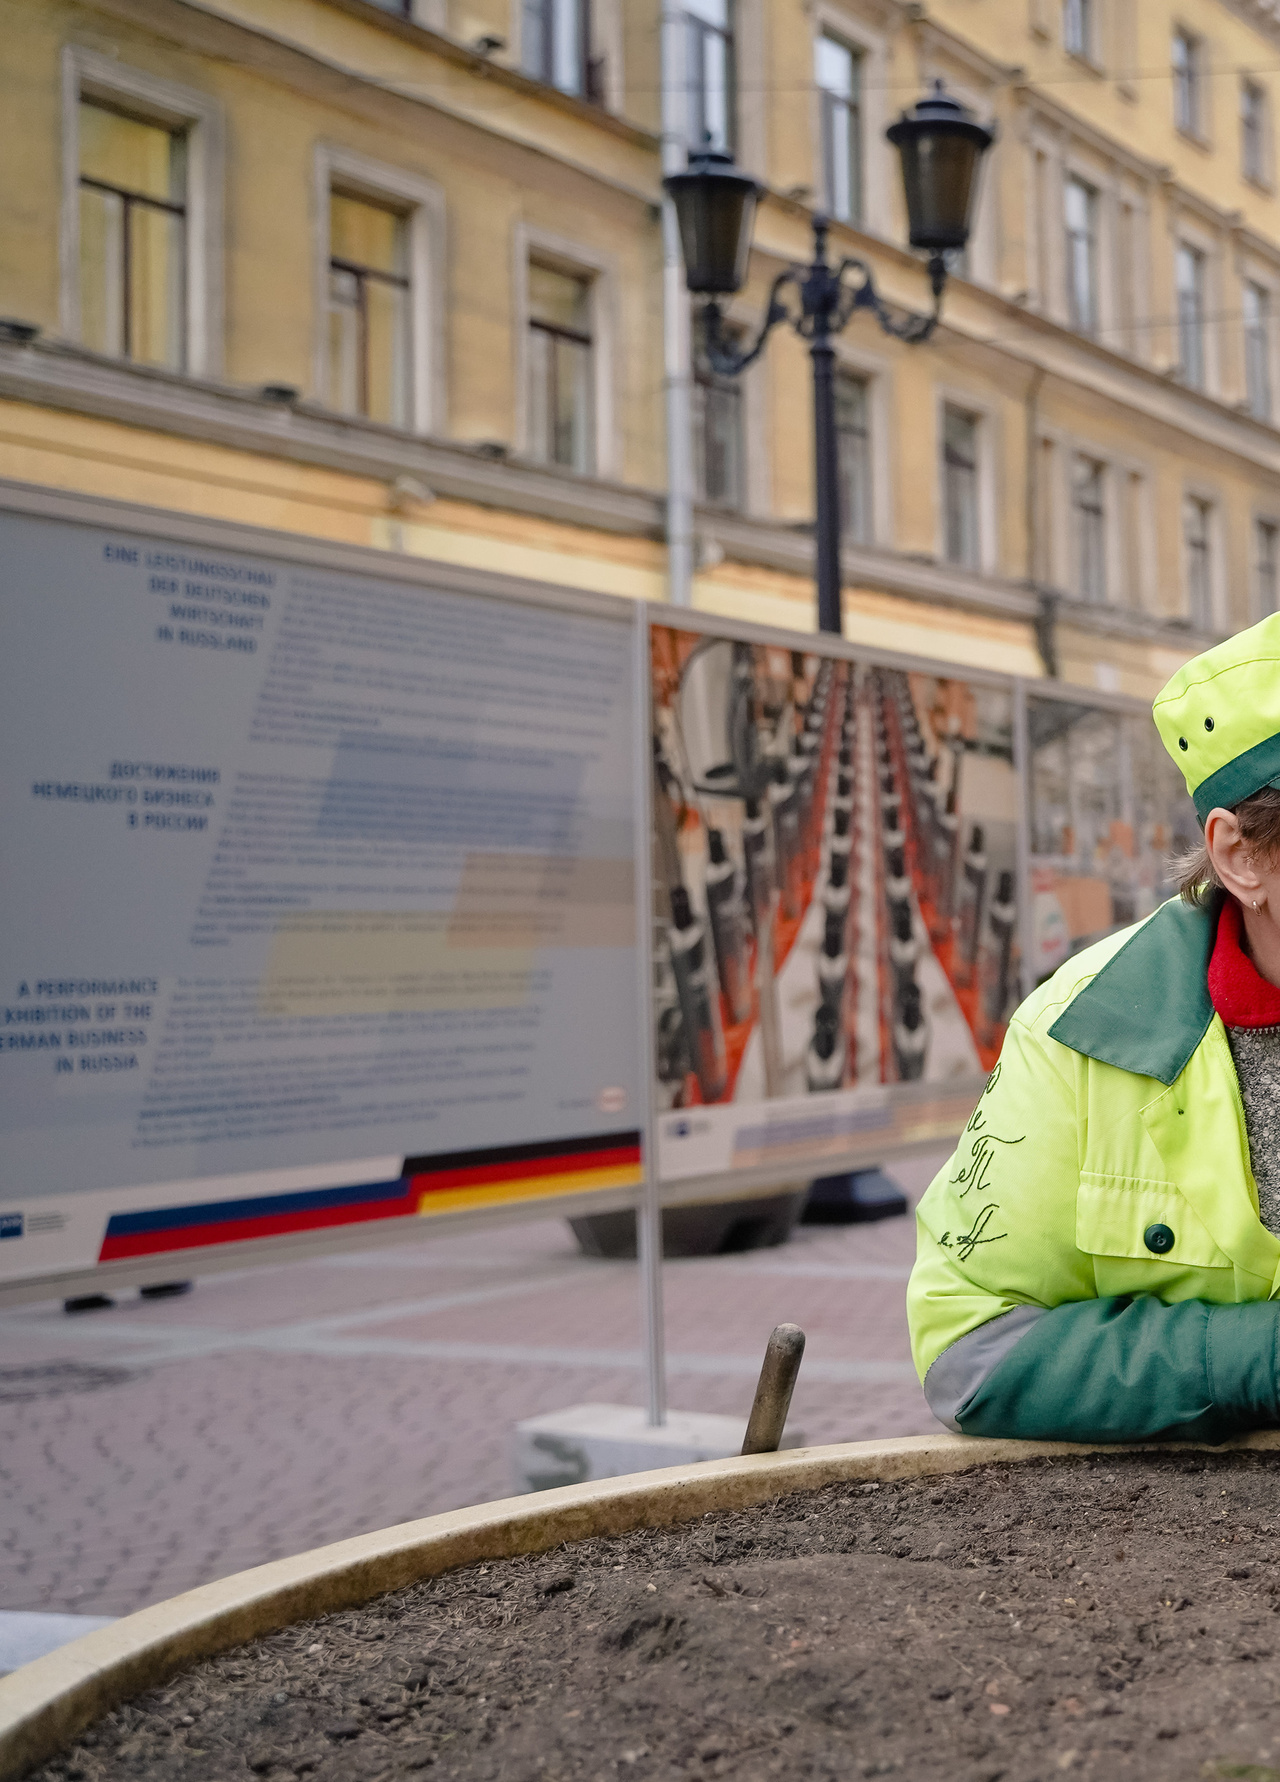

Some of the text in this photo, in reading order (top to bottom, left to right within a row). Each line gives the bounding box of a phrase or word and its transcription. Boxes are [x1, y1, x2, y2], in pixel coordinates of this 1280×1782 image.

[33, 783, 213, 807] НЕМЕЦКОГО БИЗНЕСА
[144, 813, 207, 829] РОССИИ
[19, 979, 157, 997] A PERFORMANCE
[4, 1003, 151, 1025] XHIBITION OF THE
[68, 1030, 146, 1047] BUSINESS
[56, 1054, 138, 1071] IN RUSSIA
